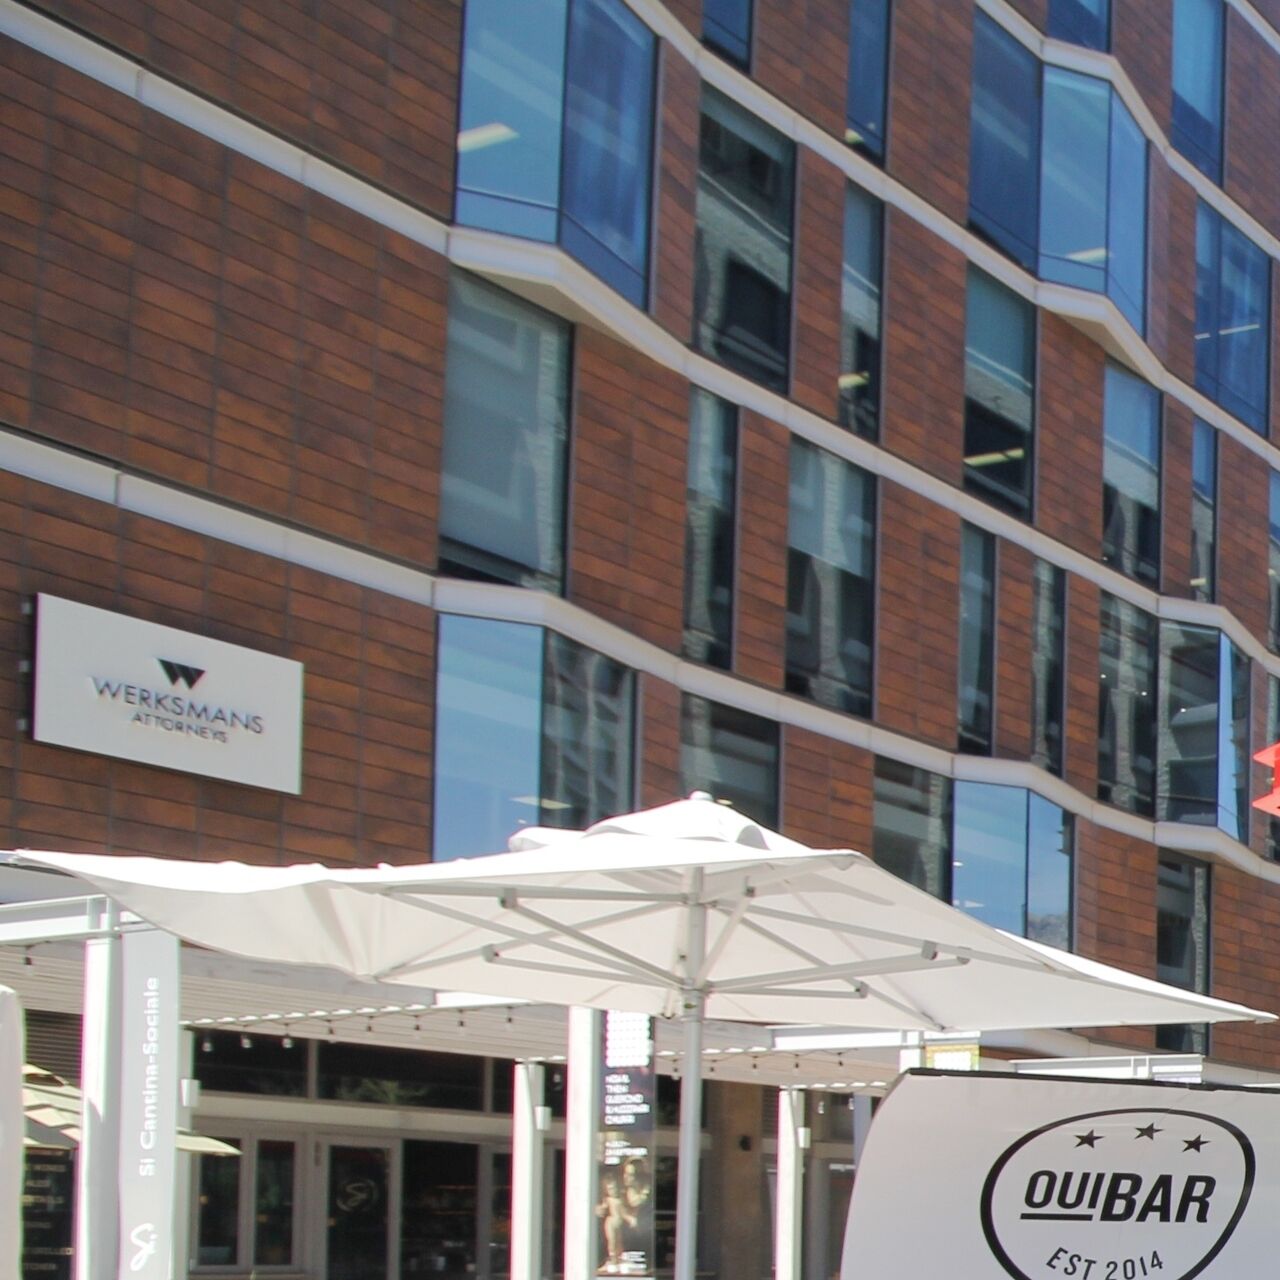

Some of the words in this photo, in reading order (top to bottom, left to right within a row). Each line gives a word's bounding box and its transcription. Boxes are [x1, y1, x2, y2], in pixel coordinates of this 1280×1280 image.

[90, 676, 264, 735] WERKSMANS
[131, 713, 228, 744] ATTORNEYS
[1023, 1169, 1217, 1223] OUIBAR
[1046, 1247, 1097, 1280] EST
